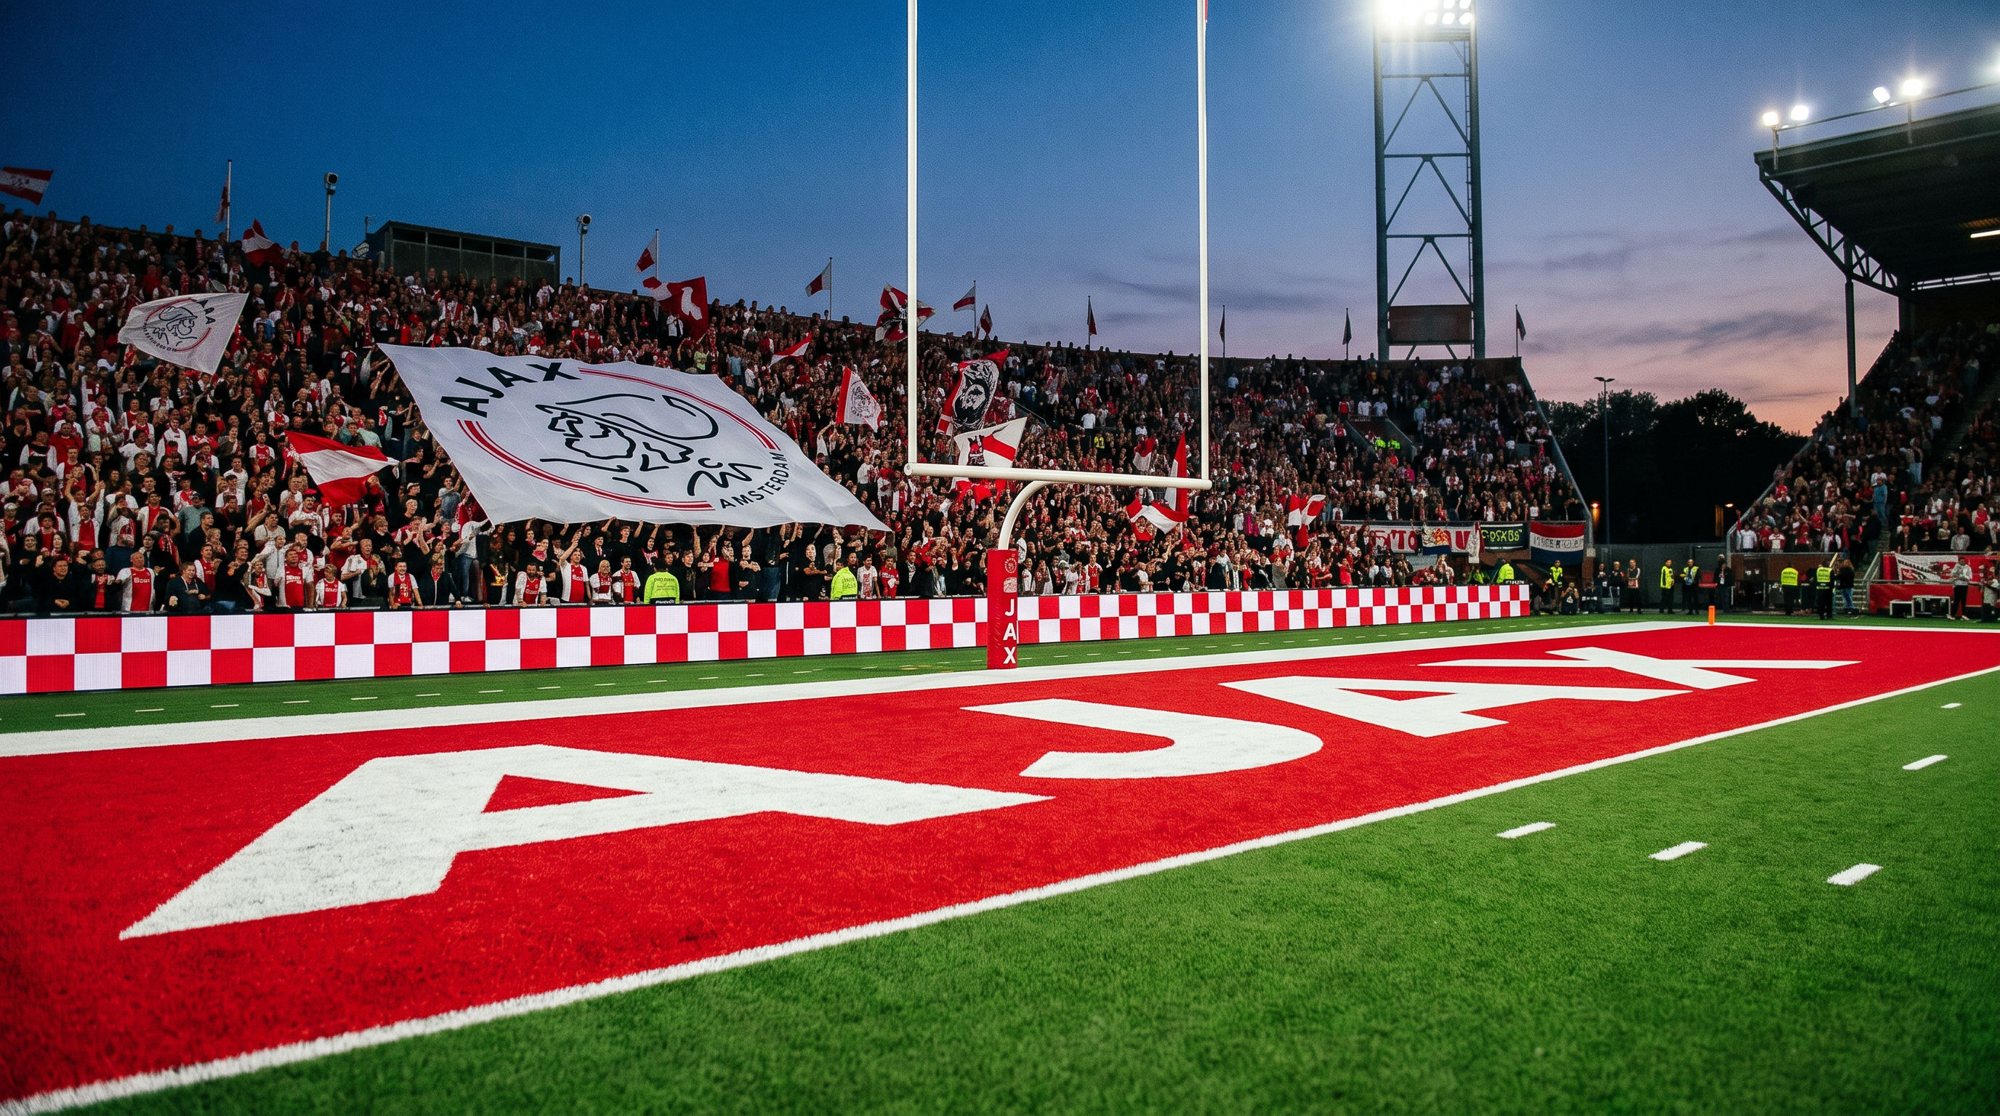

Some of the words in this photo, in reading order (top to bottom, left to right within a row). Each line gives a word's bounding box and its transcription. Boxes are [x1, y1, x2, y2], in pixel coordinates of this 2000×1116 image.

[440, 362, 582, 418] AJAX
[720, 451, 789, 508] AMSTERDAM
[120, 647, 1859, 940] AJAX
